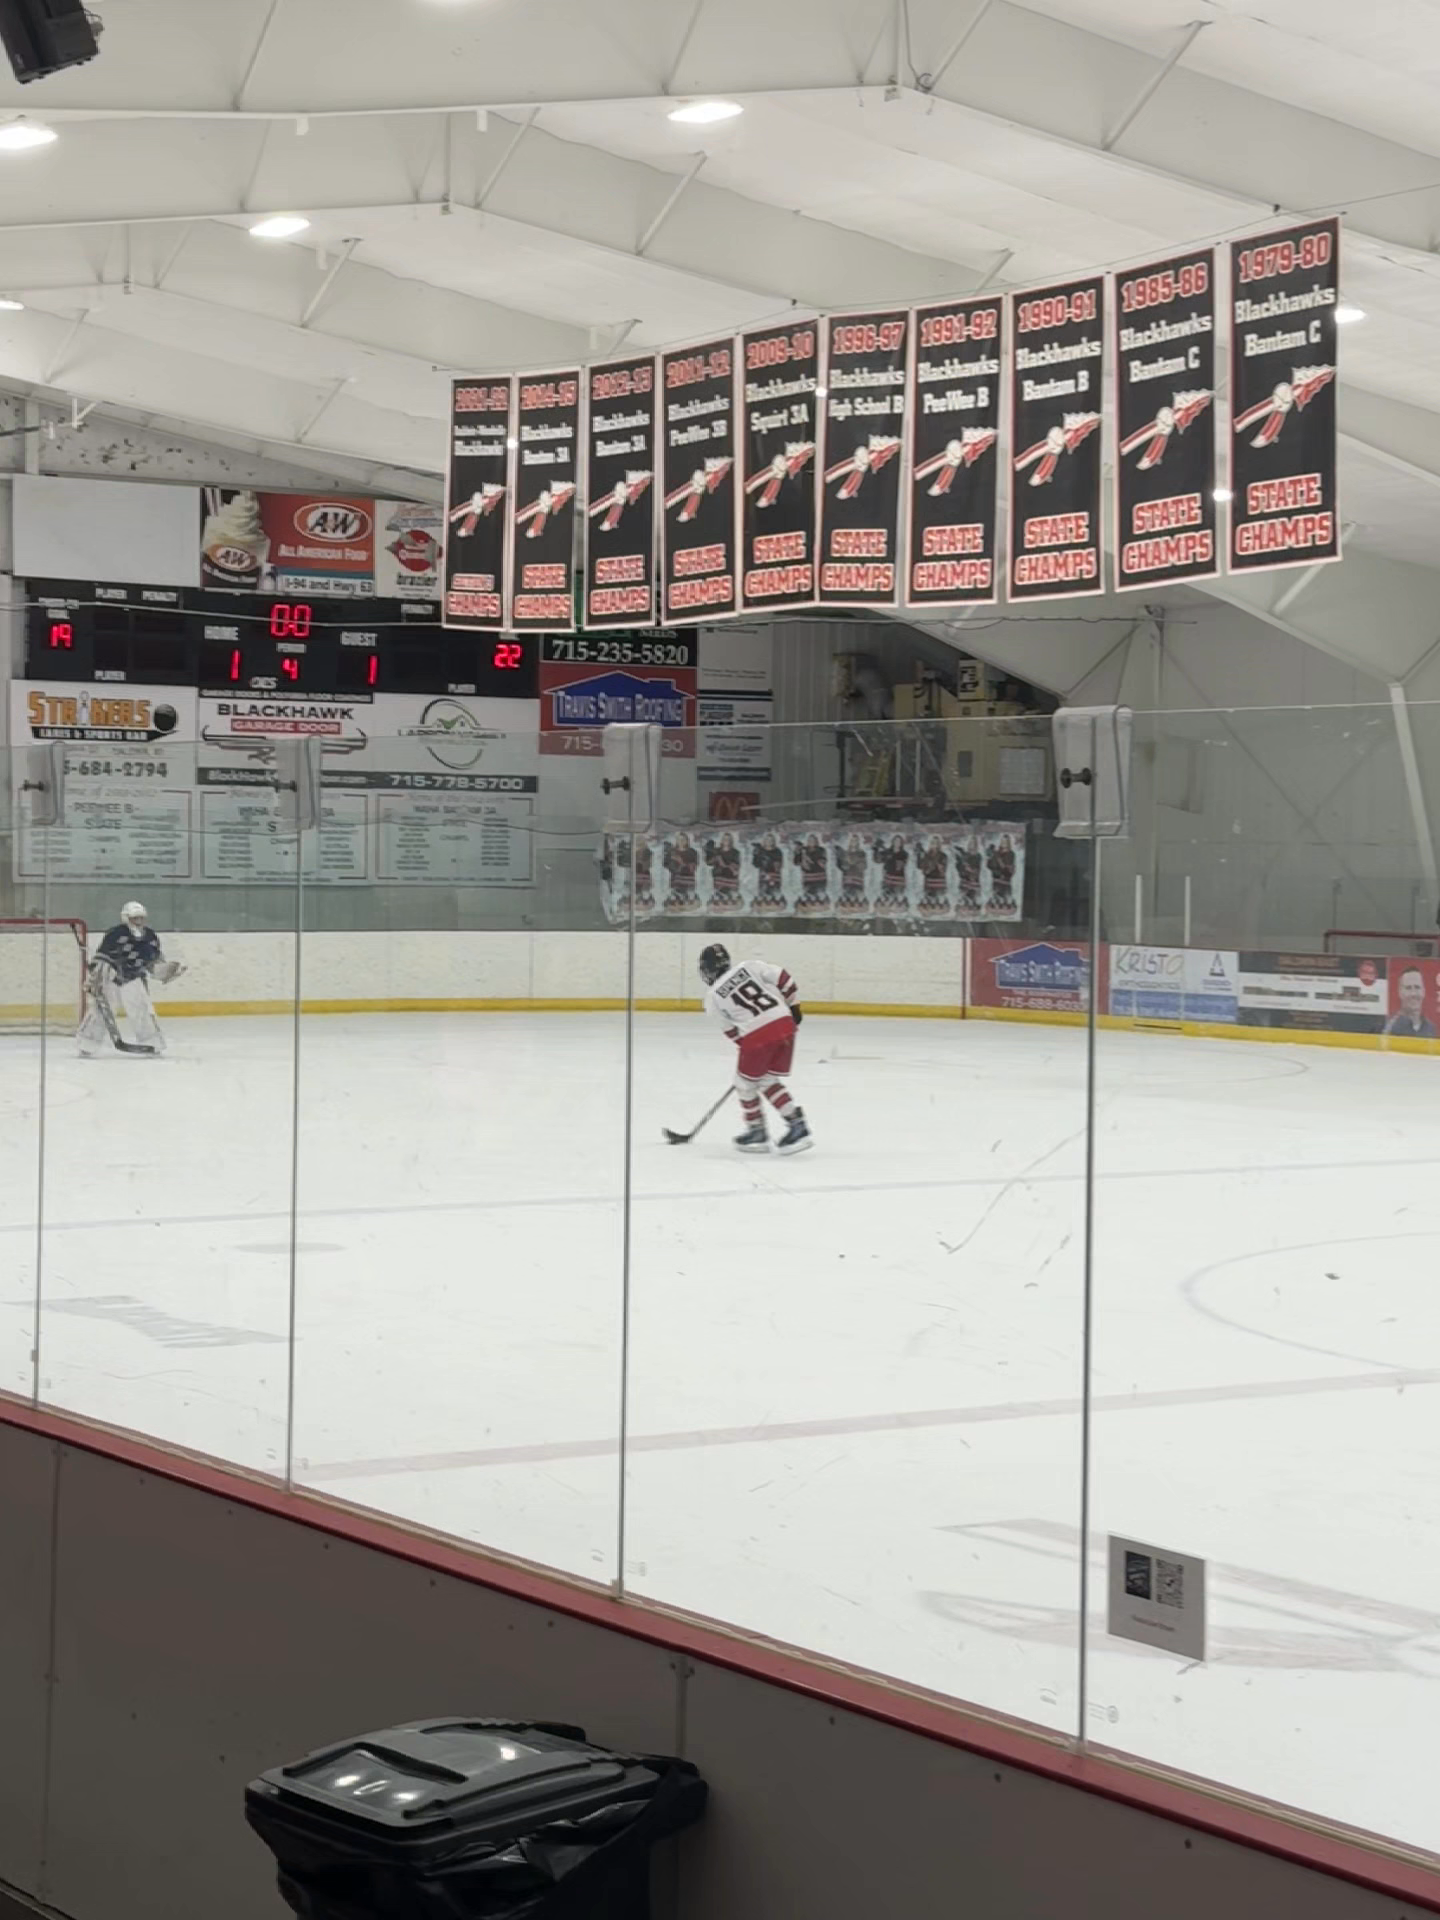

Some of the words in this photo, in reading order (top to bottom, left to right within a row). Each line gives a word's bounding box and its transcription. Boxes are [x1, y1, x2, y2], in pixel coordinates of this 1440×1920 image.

[1238, 232, 1331, 283] 1979-80
[1121, 262, 1208, 312] 1985-86
[1018, 289, 1096, 332] 1990-91
[1235, 284, 1335, 324] Blackhawks
[833, 322, 905, 354] 1996-97
[921, 309, 997, 347] 1991-92
[1120, 312, 1212, 351] Blackhawks
[1244, 327, 1306, 357] Bantam
[1309, 320, 1321, 343] C
[917, 355, 999, 383] Blackhawks
[1016, 338, 1101, 370] Blackhawks
[1130, 354, 1186, 383] Bantam
[1187, 346, 1200, 369] C
[977, 387, 989, 407] B
[1077, 371, 1089, 392] B
[1247, 473, 1321, 515] STATE
[1024, 512, 1089, 548] STATE
[1133, 493, 1201, 534] STATE
[831, 529, 887, 557] STATE
[923, 523, 984, 556] STATE
[1236, 512, 1332, 555] CHAMPS
[1015, 548, 1096, 585] CHAMPS
[1123, 530, 1212, 573] CHAMPS
[745, 564, 812, 598] CHAMPS
[821, 563, 894, 591] CHAMPS
[914, 559, 991, 591] CHAMPS
[230, 650, 240, 681] 1
[494, 643, 523, 669] 22
[552, 639, 689, 665] 715-235-5820
[281, 658, 298, 680] 4
[368, 656, 378, 685] 1
[217, 703, 354, 719] BLACKHAWK
[233, 720, 295, 731] GARAGE
[300, 722, 338, 733] DOOR
[391, 774, 523, 790] 715-778-5700
[731, 979, 779, 1017] 18
